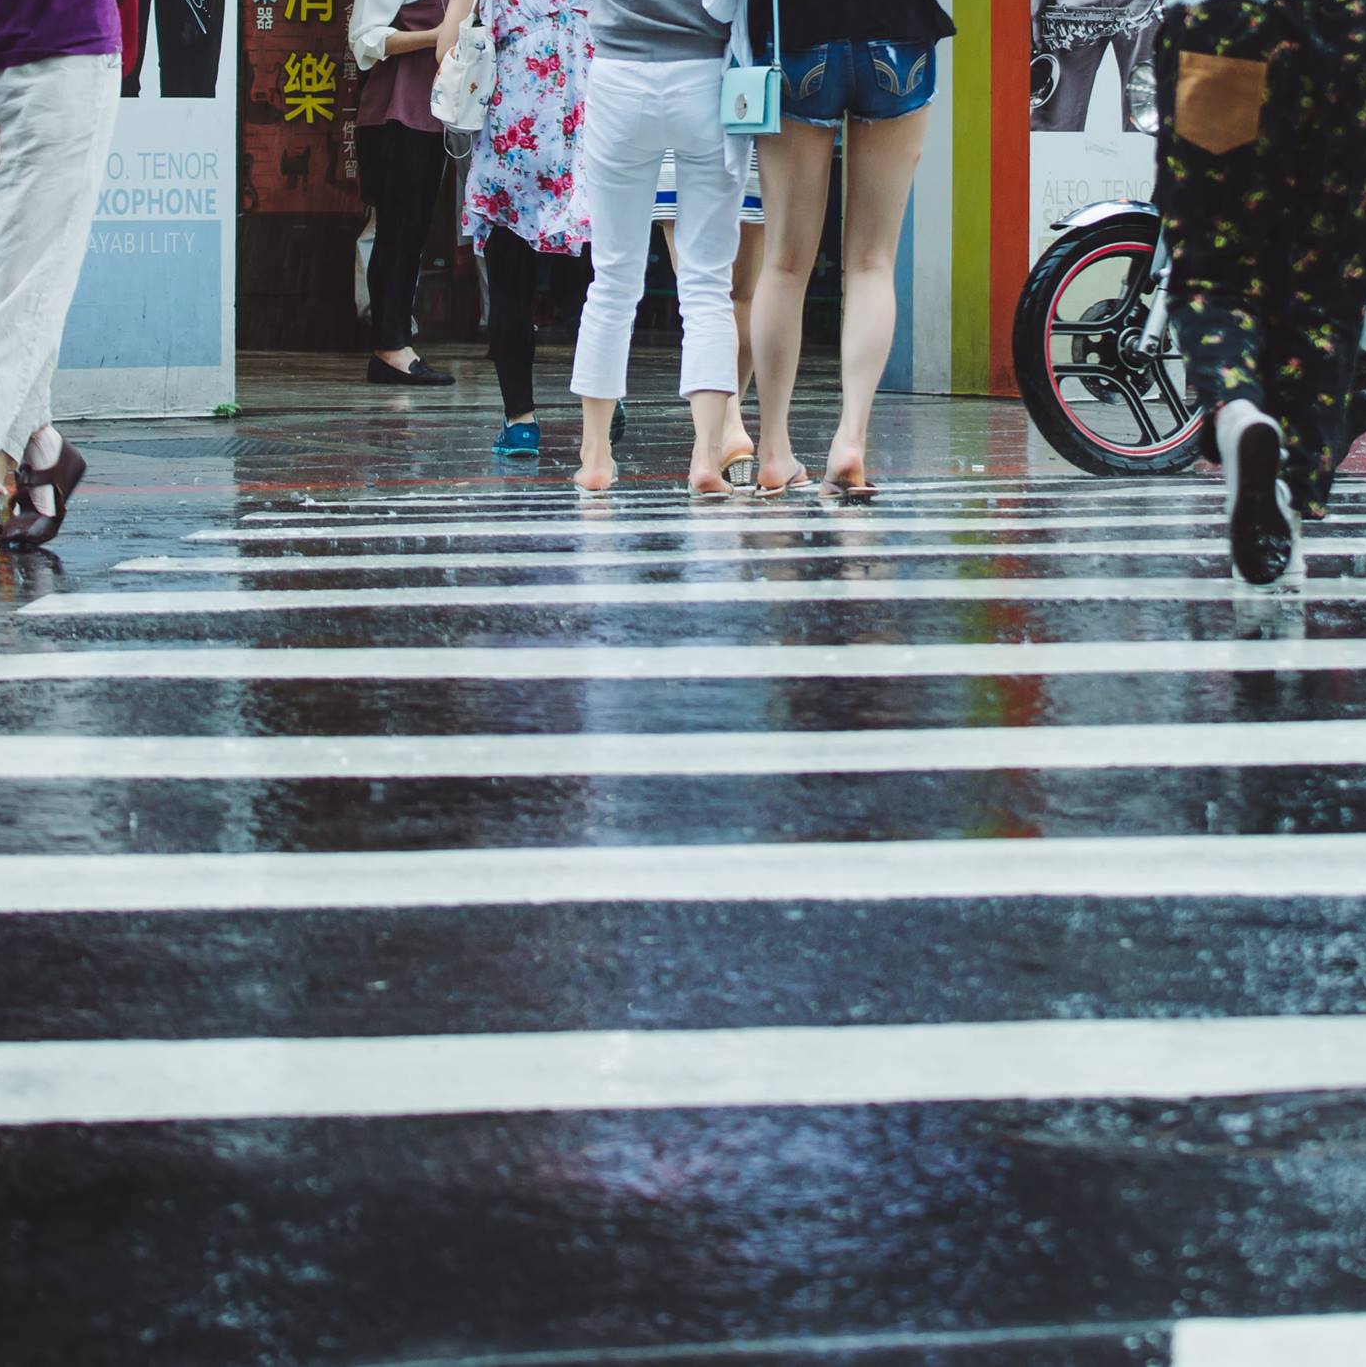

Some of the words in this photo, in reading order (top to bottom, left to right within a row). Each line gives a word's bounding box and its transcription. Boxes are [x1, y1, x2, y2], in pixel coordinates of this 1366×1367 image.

[138, 152, 219, 180] TENOR
[95, 188, 218, 216] XOPHONE
[1043, 180, 1090, 205] ALTO
